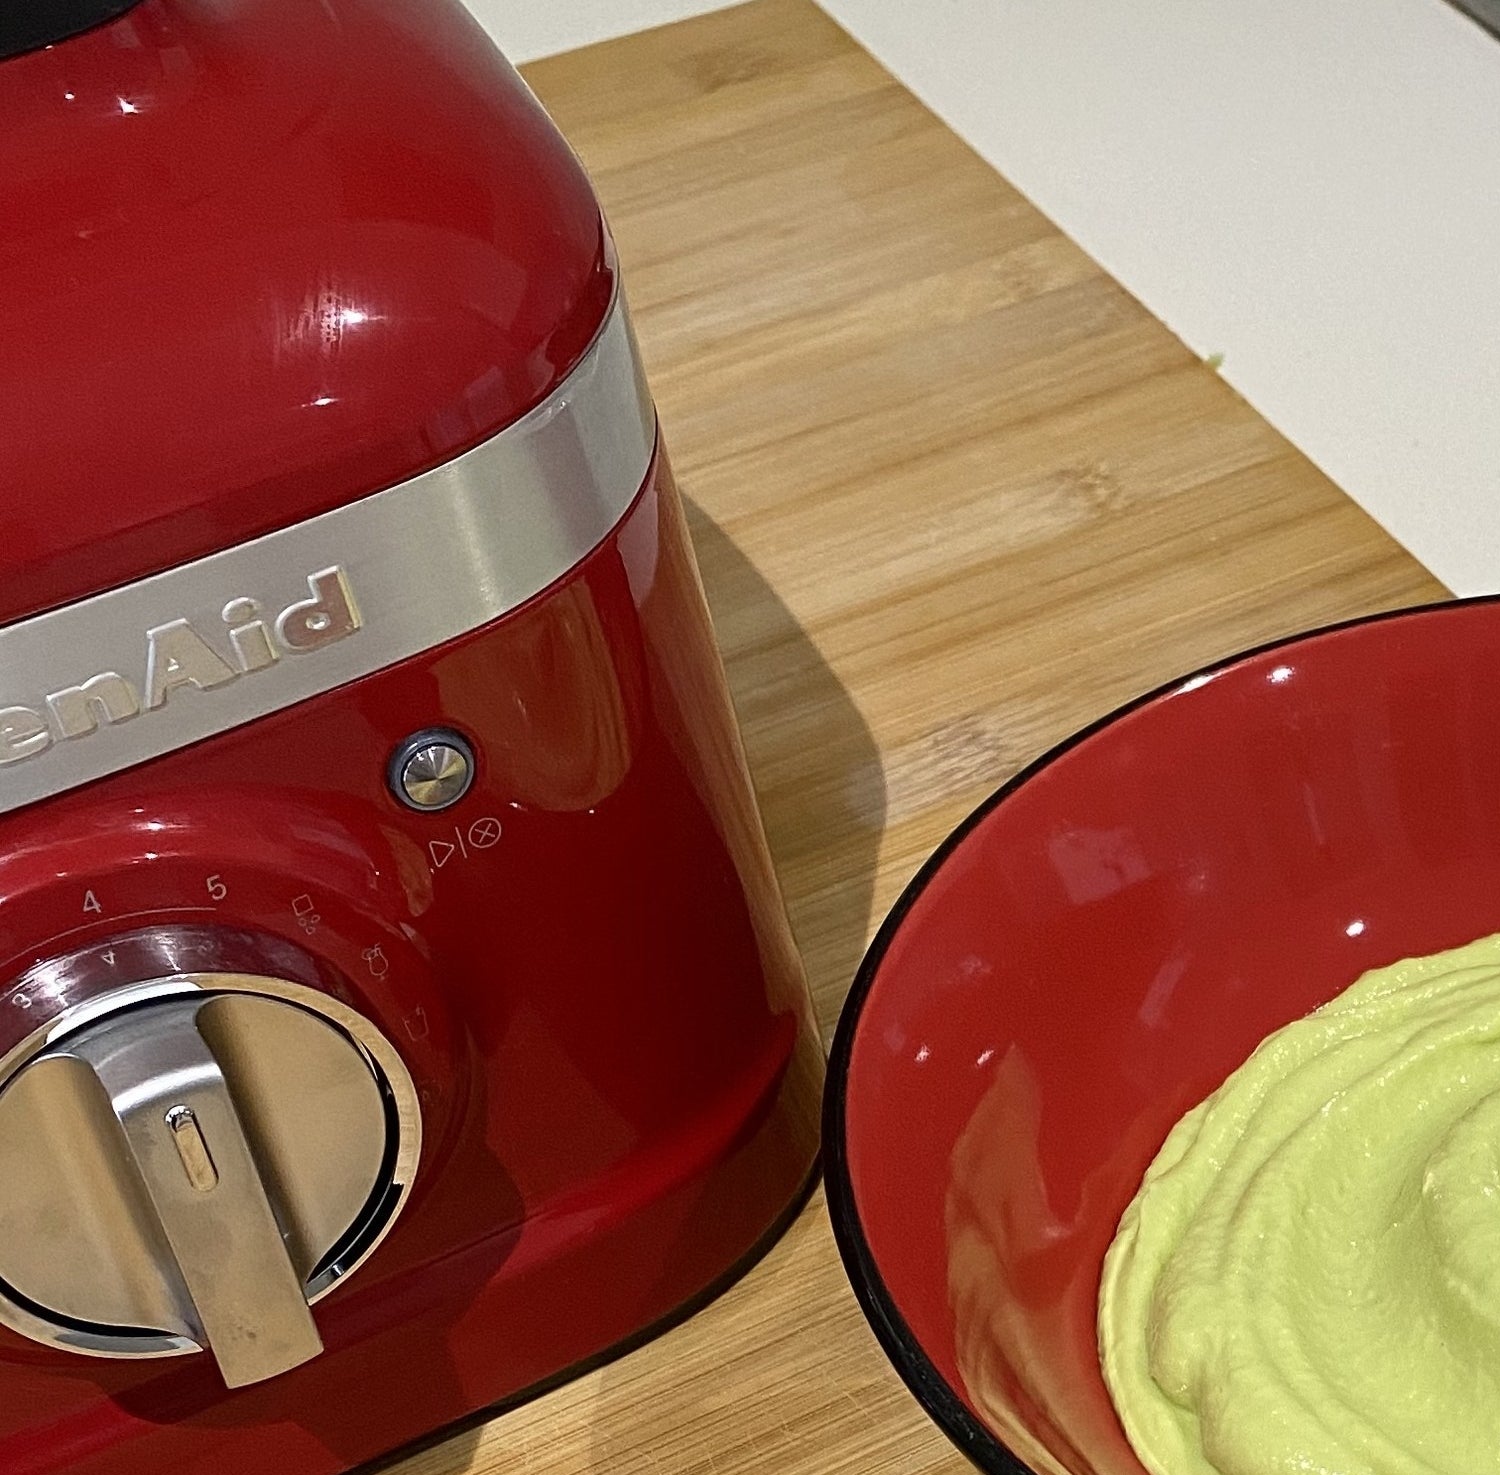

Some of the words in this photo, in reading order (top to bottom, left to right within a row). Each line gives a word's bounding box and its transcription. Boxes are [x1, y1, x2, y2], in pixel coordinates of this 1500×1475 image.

[0, 565, 362, 767] enAid
[82, 889, 102, 913] 4
[206, 874, 227, 900] 5
